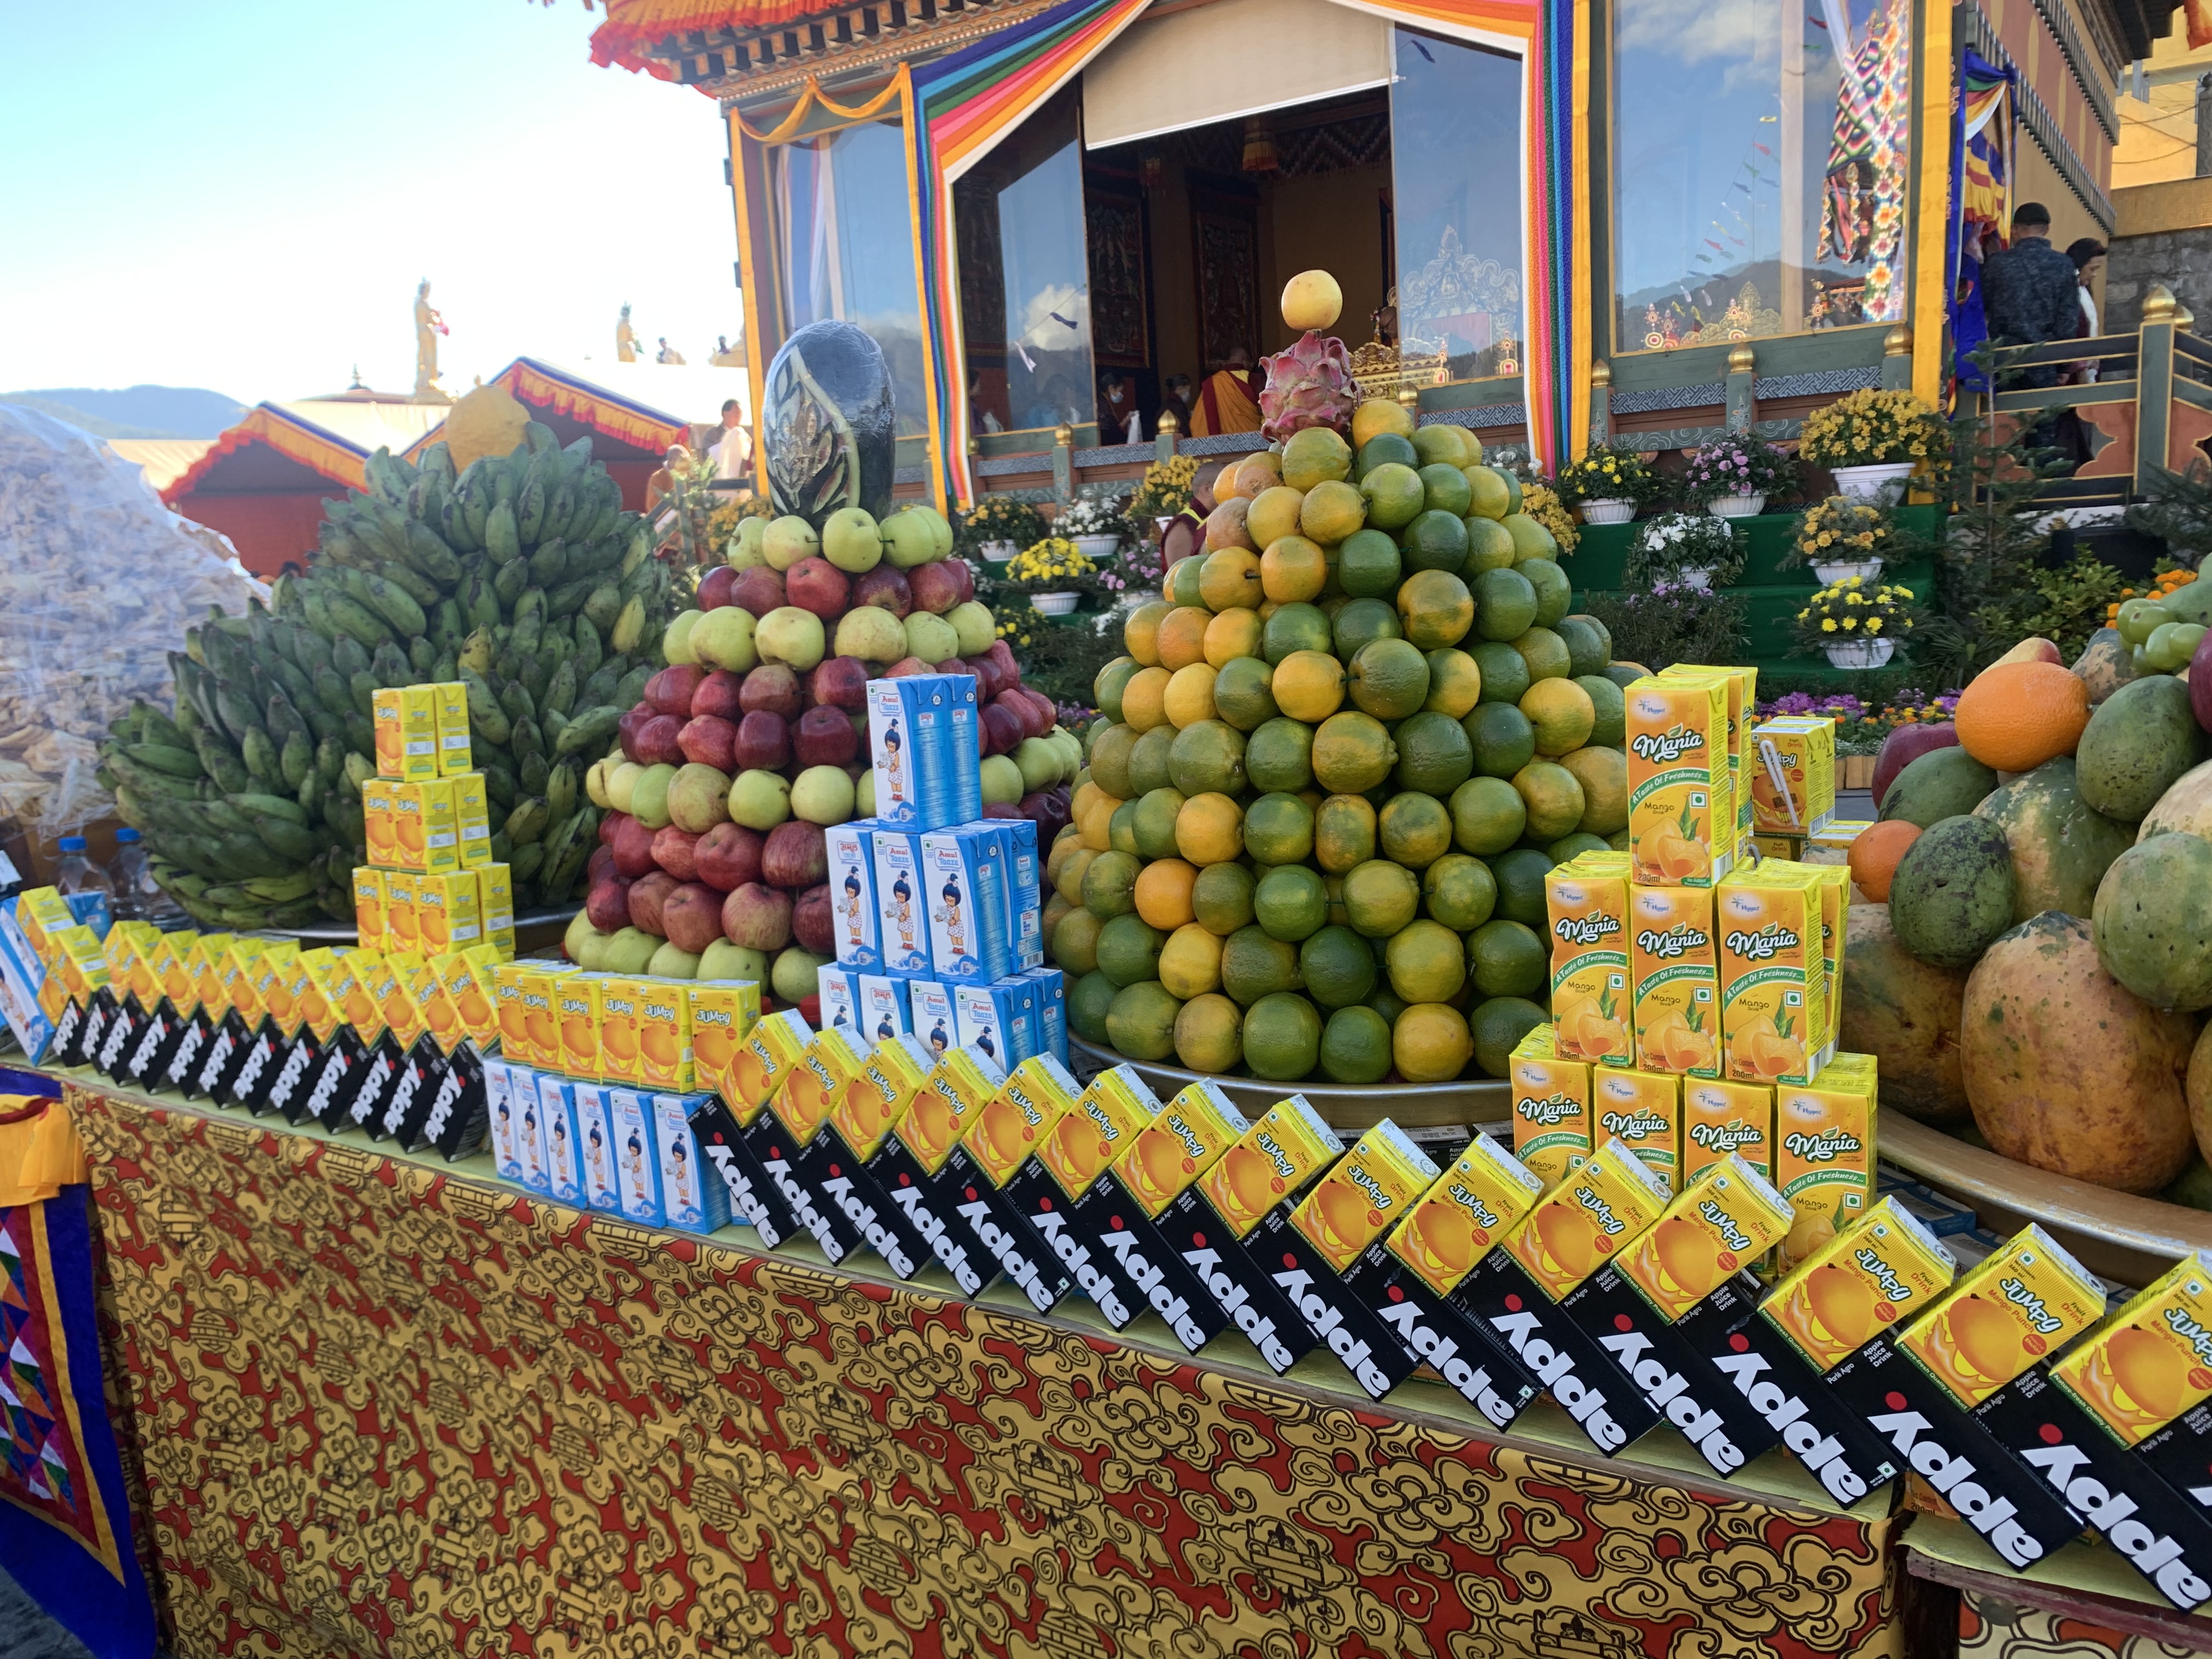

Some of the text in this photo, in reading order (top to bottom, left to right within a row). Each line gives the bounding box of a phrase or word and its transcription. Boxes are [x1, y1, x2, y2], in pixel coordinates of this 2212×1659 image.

[882, 693, 899, 703] Amul
[1632, 730, 1703, 763] Mania
[1636, 783, 1654, 798] Taste
[1645, 803, 1674, 812] Mango
[889, 845, 909, 855] Amul
[938, 848, 958, 859] Amul
[1556, 917, 1620, 944] Mania
[1638, 929, 1706, 957] Mania
[1726, 930, 1798, 959] Mania
[1561, 963, 1577, 978] Taste
[1568, 980, 1595, 991] Mango
[1643, 977, 1660, 990] Taste
[1660, 972, 1668, 980] Of
[1732, 979, 1748, 993] Taste
[1749, 974, 1757, 983] Of
[499, 985, 520, 998] JUMP
[1651, 994, 1680, 1005] Mango
[927, 995, 945, 1005] Amul
[972, 1001, 991, 1011] Amul
[1739, 998, 1769, 1008] Mango
[1518, 1098, 1581, 1124] Mania
[1602, 1114, 1668, 1138] Mania
[1691, 1124, 1763, 1151] Mania
[1523, 1141, 1537, 1154] Taste
[1785, 1134, 1861, 1161] Mania
[1530, 1159, 1557, 1170] Mango
[1340, 1173, 1376, 1208] Mango Punch
[1790, 1179, 1806, 1192] Taste
[1807, 1174, 1815, 1183] Of
[1796, 1197, 1828, 1209] Mango
[1441, 1194, 1480, 1229] Mango Punch
[1566, 1196, 1604, 1234] Mango Punch
[1624, 1207, 1641, 1227] Drink
[1631, 1206, 1643, 1219] Fruit
[1689, 1211, 1728, 1251] Mango Punch
[1751, 1222, 1770, 1243] Drink
[1759, 1222, 1771, 1234] Fruit
[1843, 1259, 1886, 1301] Mango Punch
[1911, 1273, 1931, 1294] Drink
[1920, 1272, 1934, 1286] Fruit
[1711, 1285, 1729, 1301] Apple
[1715, 1293, 1731, 1306] Juice
[1638, 1289, 1654, 1305] Quality
[1653, 1304, 1670, 1322] Product
[1719, 1296, 1737, 1311] Drink
[1988, 1290, 2035, 1333] Mango Punch
[2070, 1302, 2085, 1317] Fruit
[2062, 1303, 2084, 1325] Drink
[1863, 1339, 1883, 1357] Apple
[2151, 1320, 2202, 1367] Mango Punch
[1788, 1337, 1804, 1354] Quality
[1804, 1353, 1823, 1372] Product
[1869, 1346, 1886, 1362] Juice
[1872, 1352, 1893, 1368] Drink
[1841, 1363, 1854, 1374] Agro
[2015, 1370, 2036, 1387] Apple
[2020, 1378, 2040, 1393] Juice
[1930, 1373, 1948, 1390] Quality
[1947, 1389, 1967, 1410] Product
[2025, 1382, 2047, 1398] Drink
[1990, 1393, 2006, 1404] Agro
